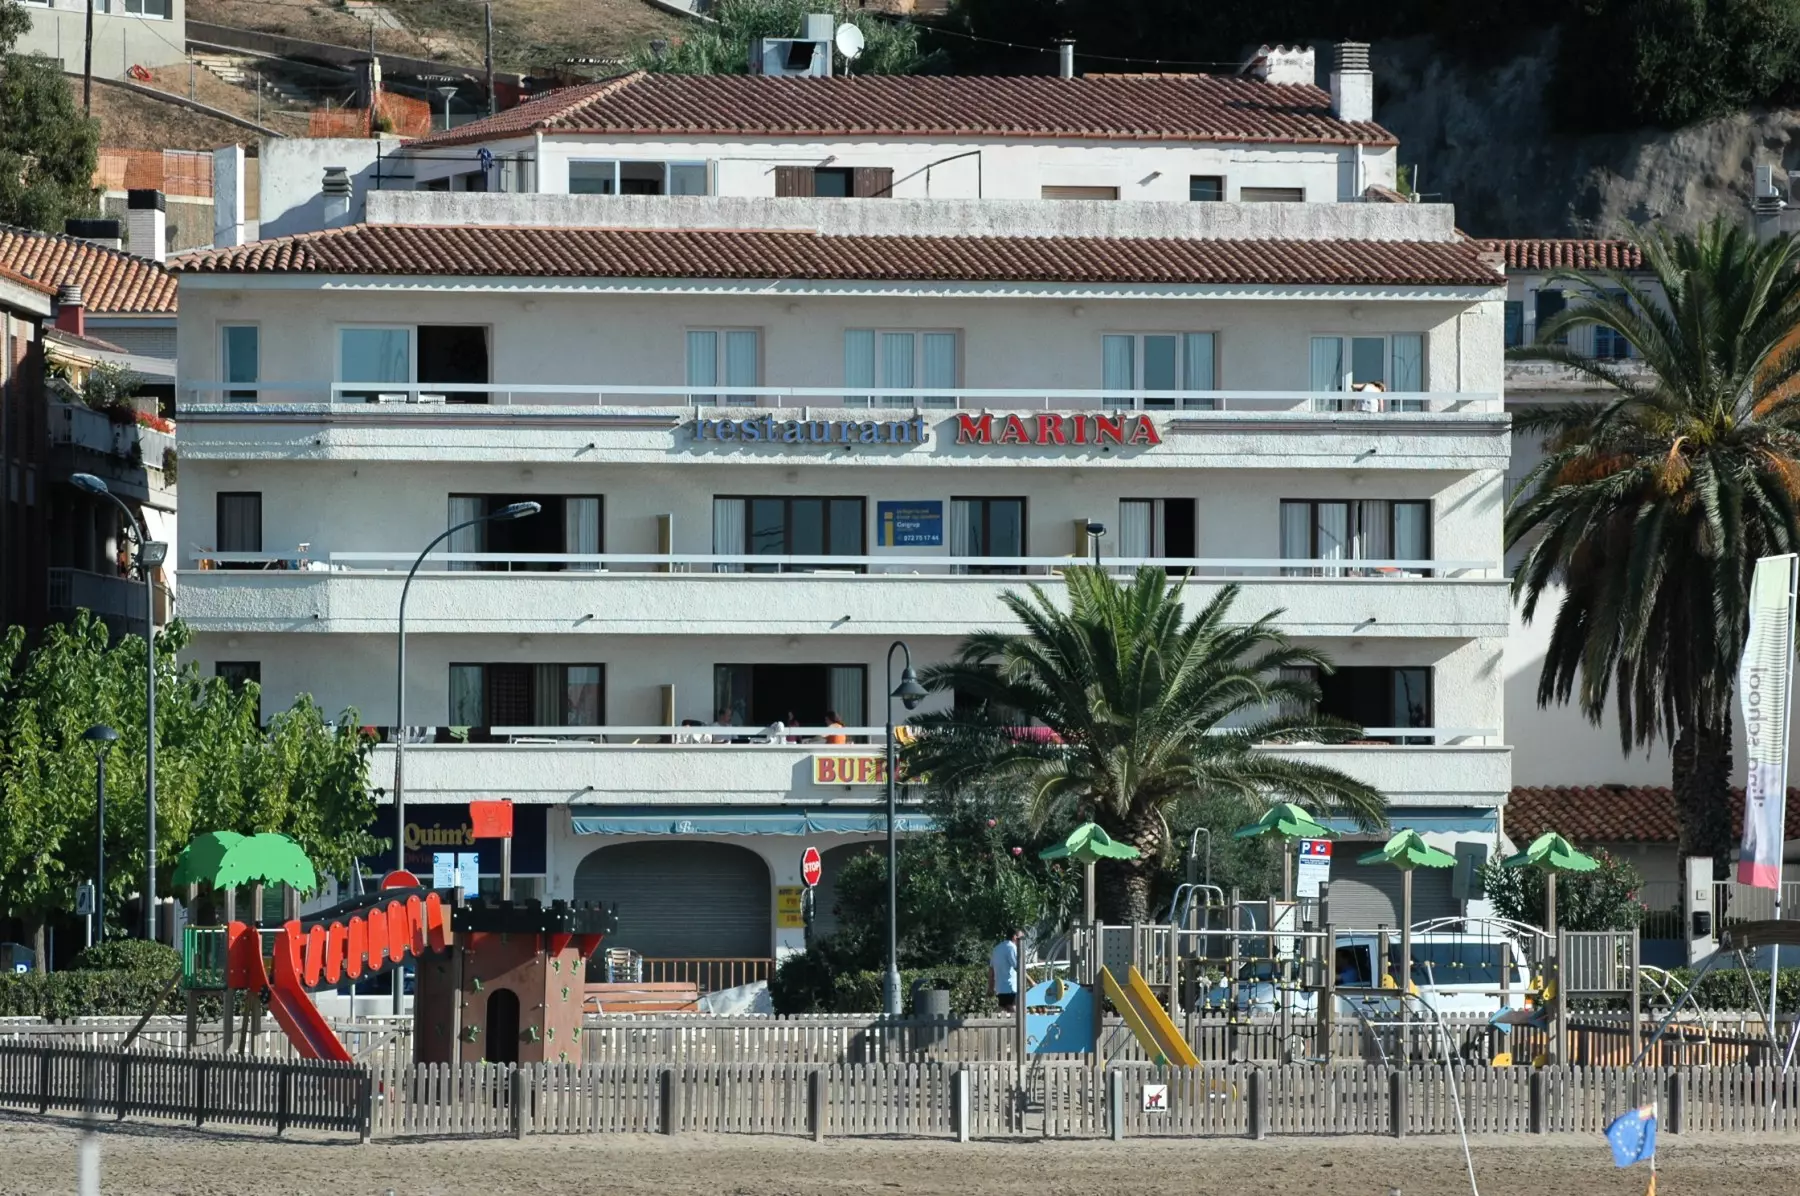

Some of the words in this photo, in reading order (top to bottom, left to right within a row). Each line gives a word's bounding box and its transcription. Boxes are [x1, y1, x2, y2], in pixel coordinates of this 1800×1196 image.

[695, 412, 930, 444] restaurant
[955, 412, 1162, 445] MARINA
[403, 822, 476, 850] Quim's
[1302, 842, 1311, 854] P
[804, 861, 820, 873] STOP
